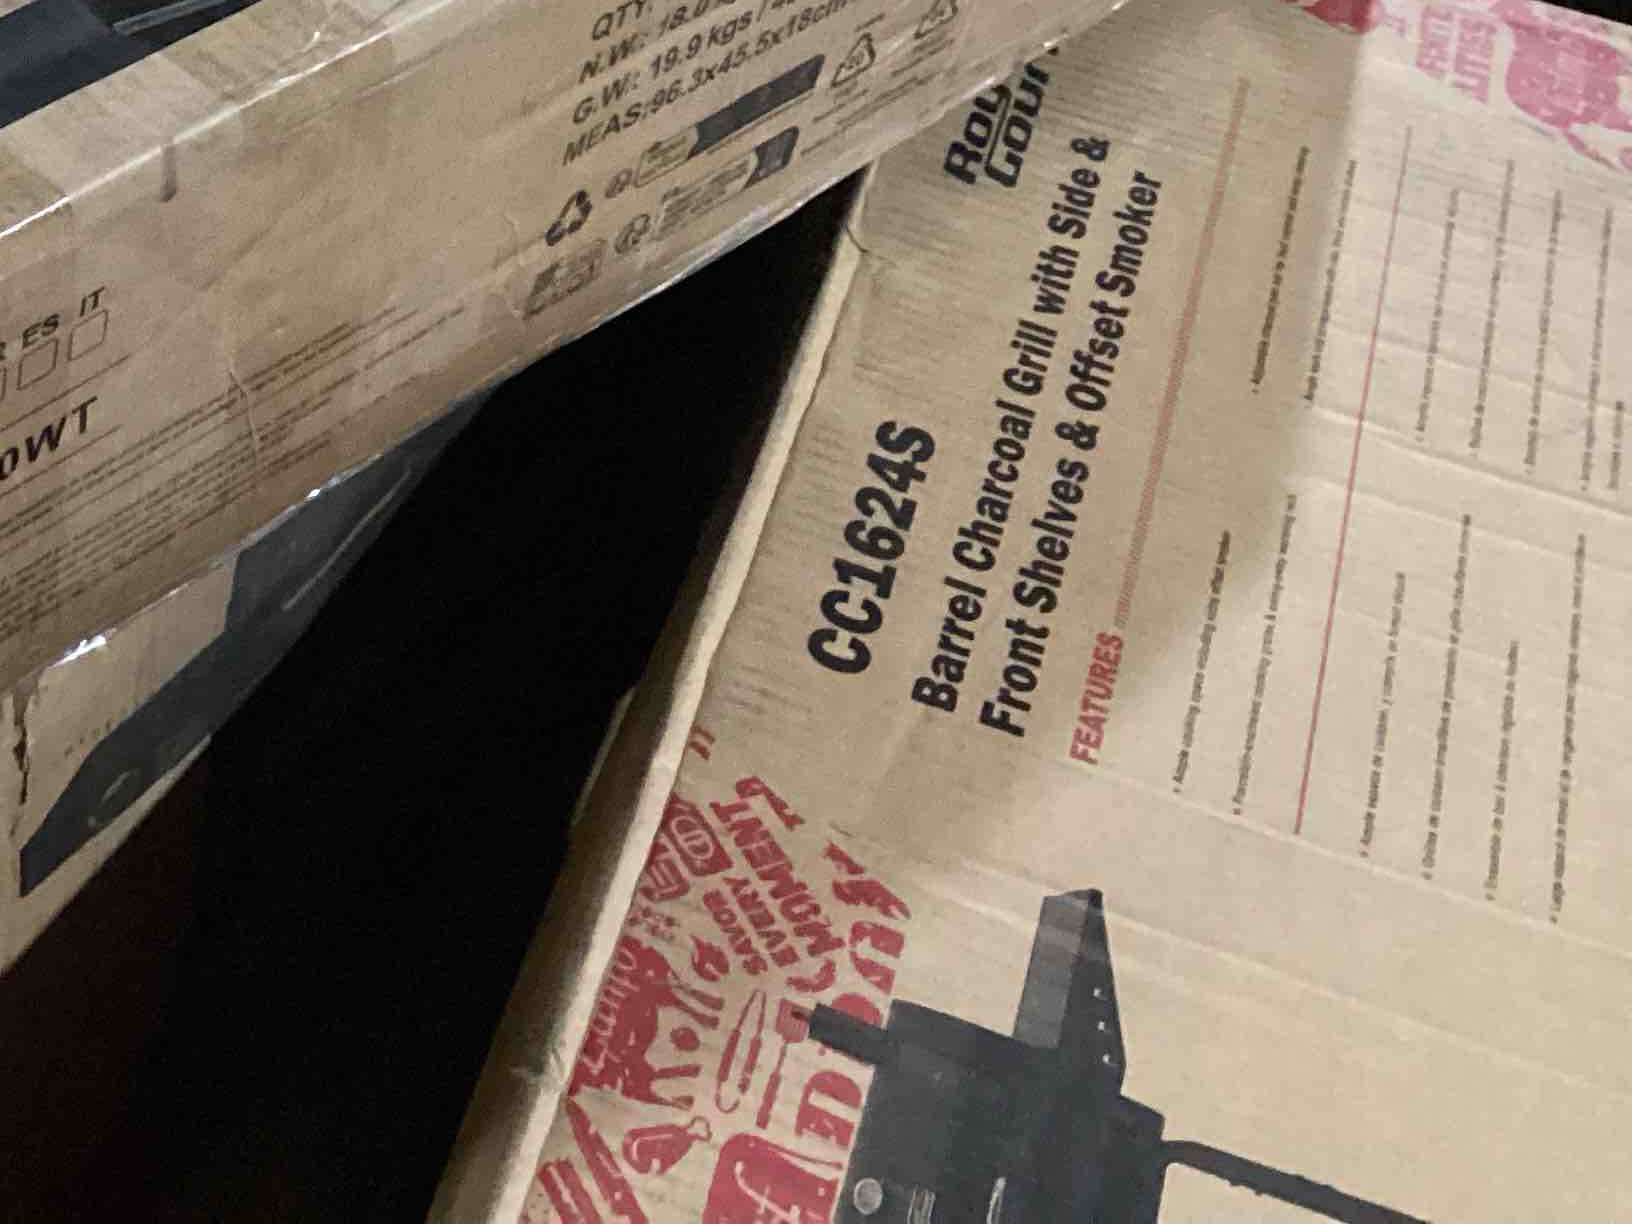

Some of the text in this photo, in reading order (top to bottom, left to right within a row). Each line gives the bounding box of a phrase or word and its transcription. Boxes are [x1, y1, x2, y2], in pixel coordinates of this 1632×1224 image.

[651, 34, 703, 80] 19.9
[706, 9, 754, 53] kgs
[21, 313, 61, 347] ES
[79, 285, 107, 319] IT
[911, 133, 1111, 714] Barrel Charcoal Grill with Side &
[979, 171, 1163, 737] Front Shelves & Offset Smoker
[806, 419, 937, 676] CC1624S
[1069, 630, 1128, 767] FEATURES
[708, 799, 847, 958] MOMENT
[722, 874, 801, 969] EVERY
